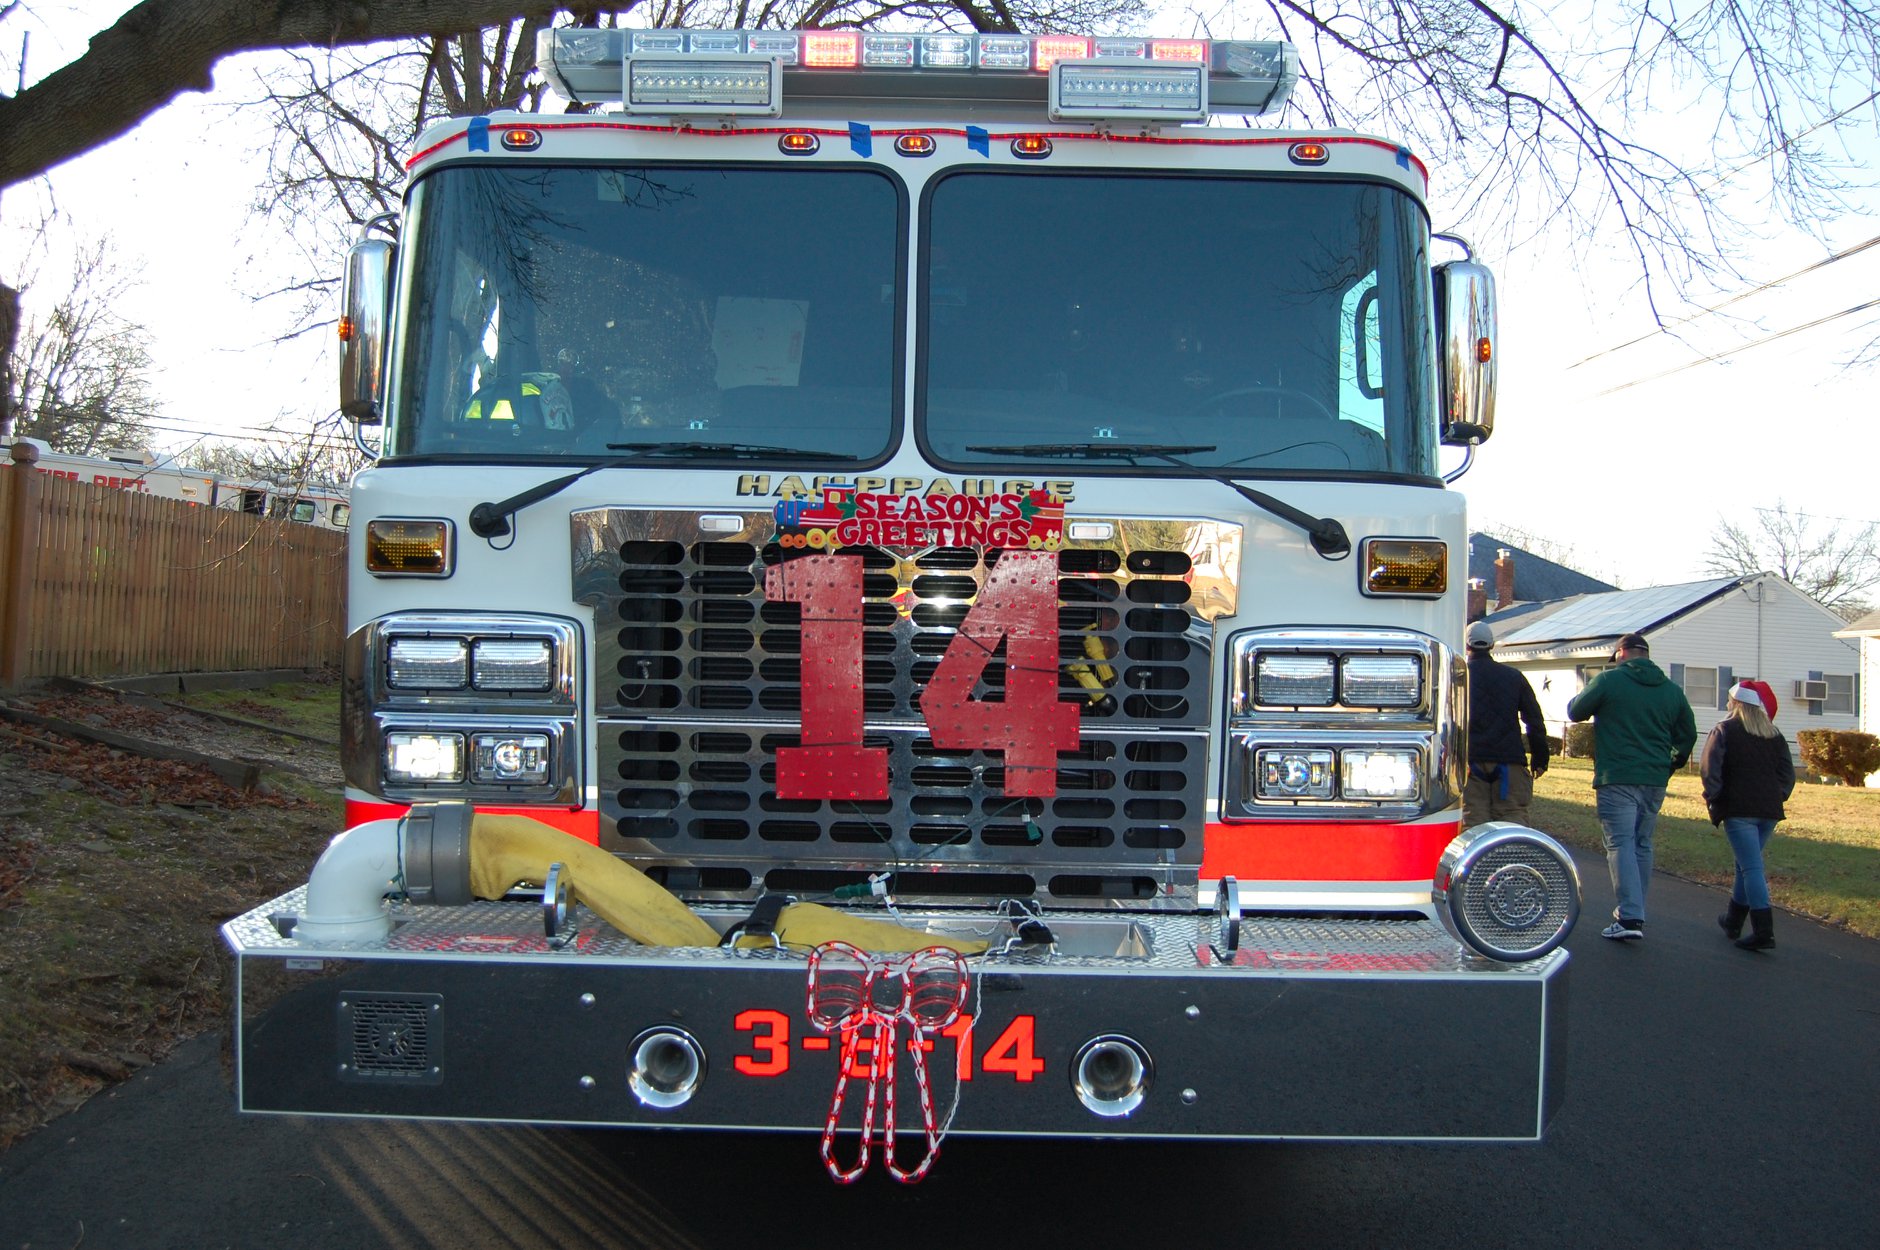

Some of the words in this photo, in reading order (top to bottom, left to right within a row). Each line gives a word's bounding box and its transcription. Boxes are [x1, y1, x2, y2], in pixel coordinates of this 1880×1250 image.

[93, 474, 150, 493] DEPT.
[736, 474, 1075, 502] HAUPPAUGE
[854, 493, 1023, 522] SEASON'S
[836, 519, 1032, 549] GREETINGS
[765, 549, 1081, 800] 14
[734, 1009, 1045, 1083] 3-8-14
